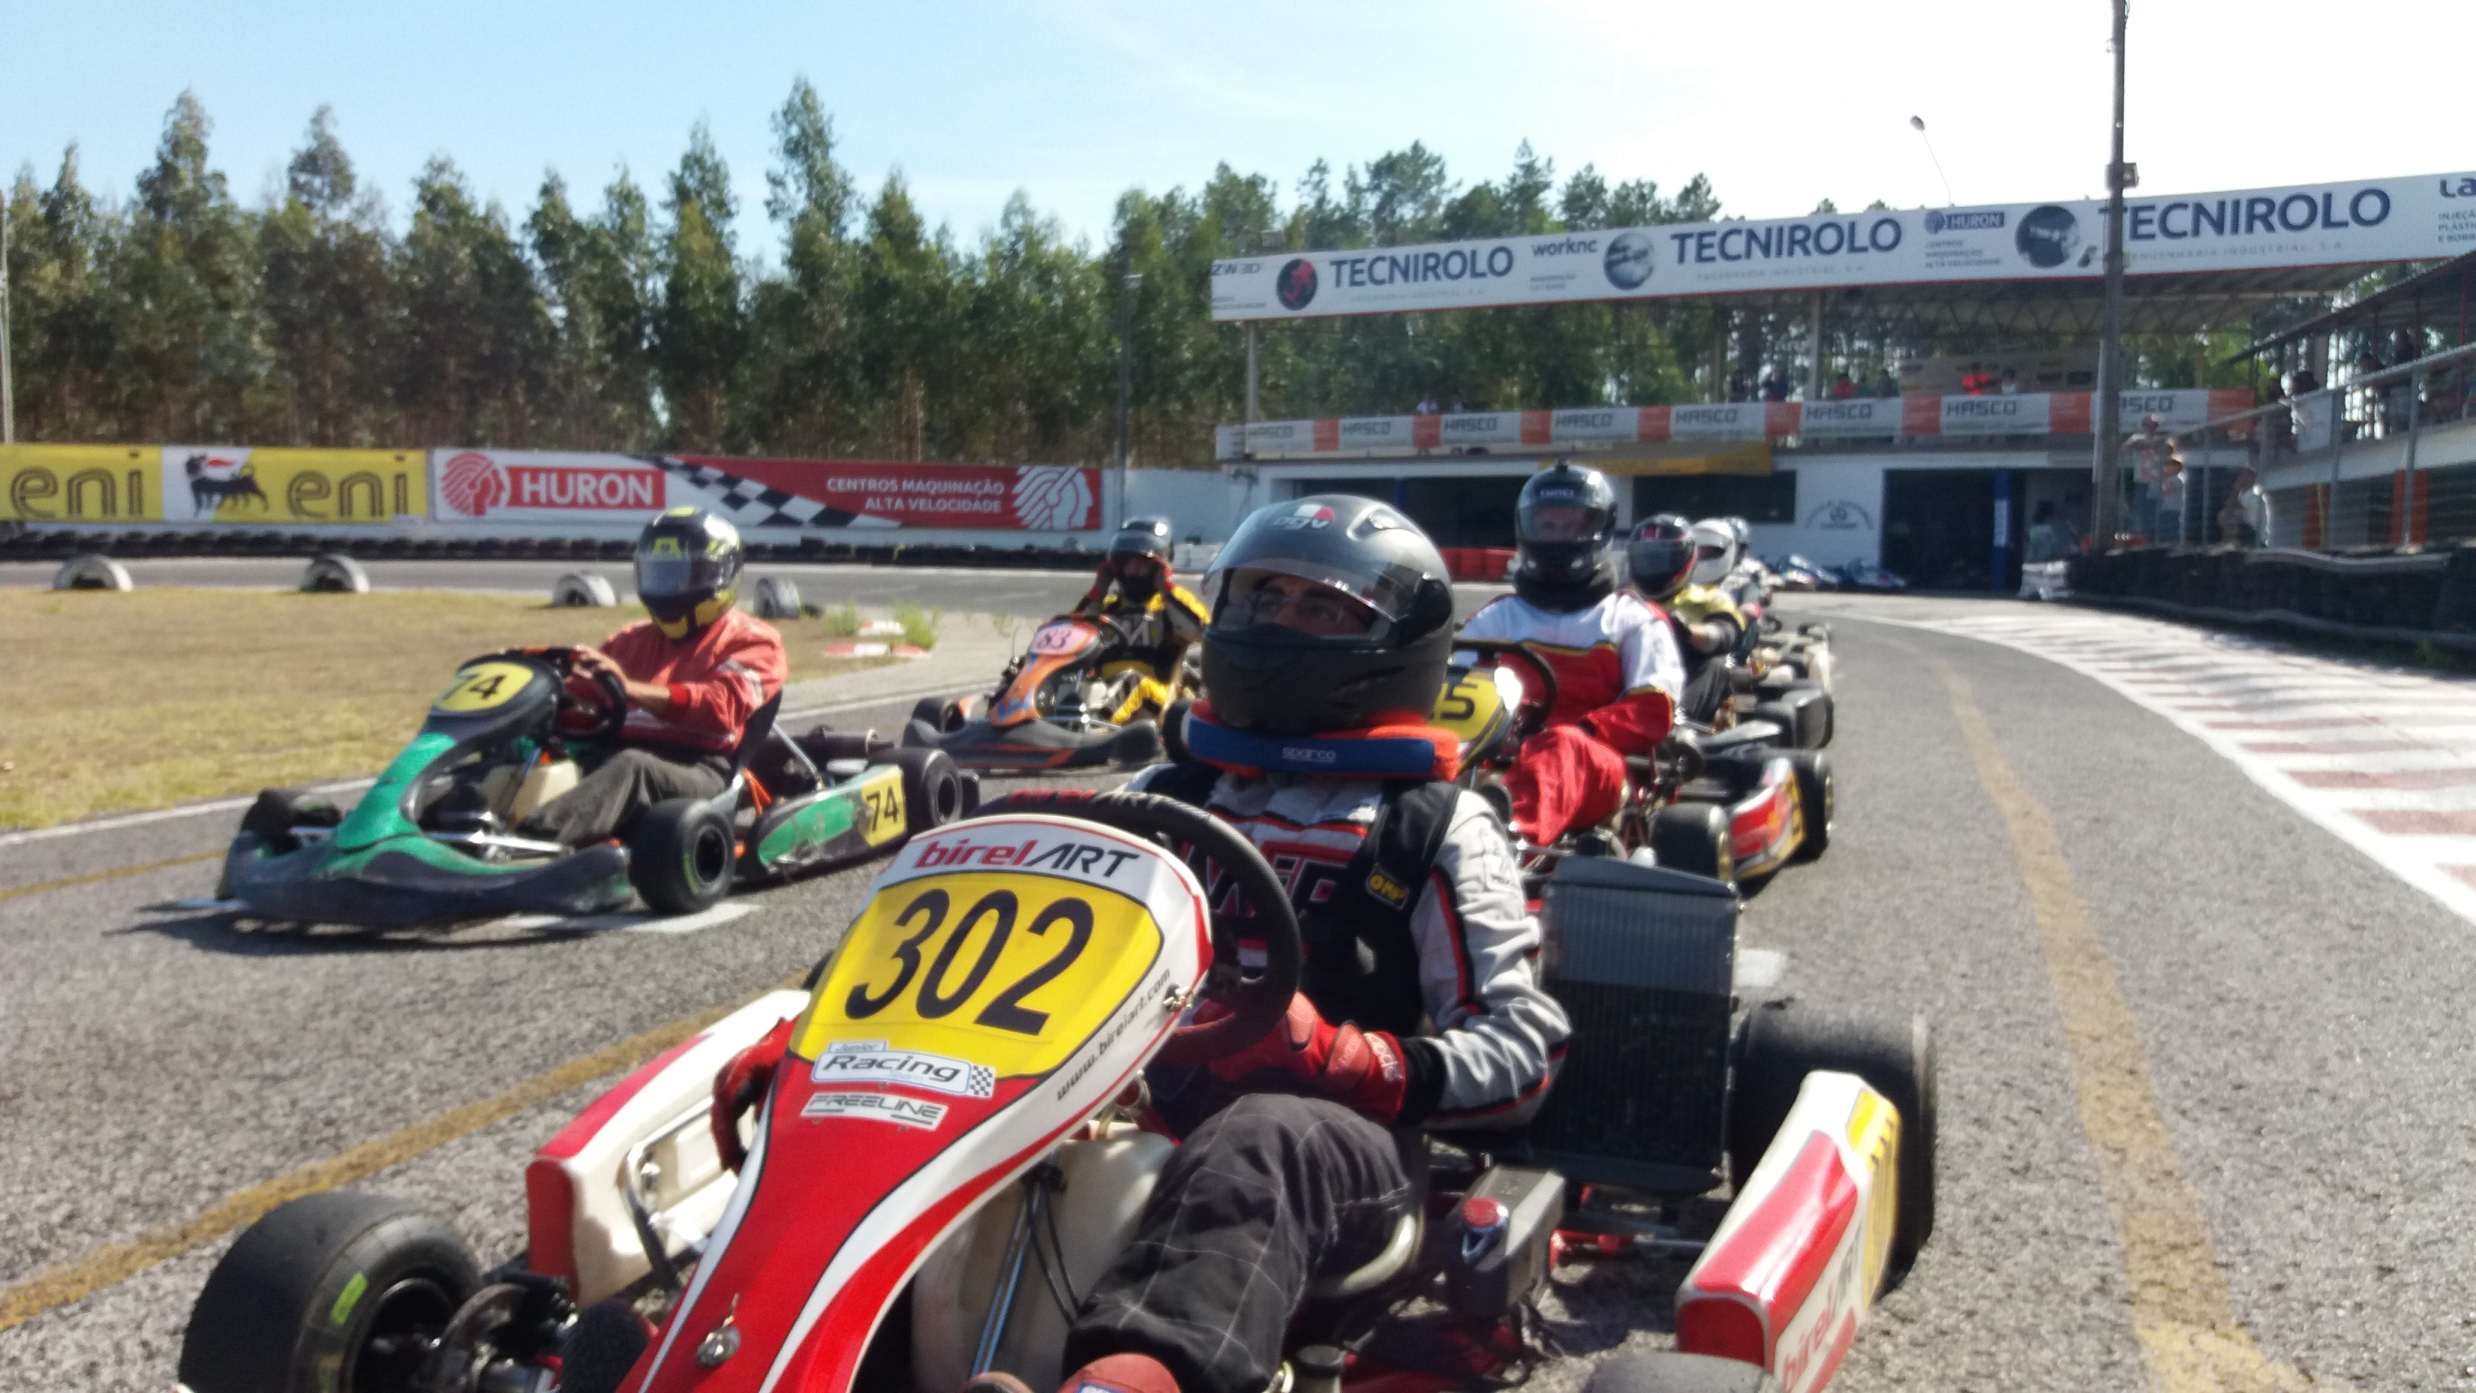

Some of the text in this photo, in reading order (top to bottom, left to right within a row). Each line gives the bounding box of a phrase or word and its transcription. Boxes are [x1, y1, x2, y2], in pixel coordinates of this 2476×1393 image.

[1950, 213, 2001, 228] HURON
[1532, 238, 1597, 257] worknc
[1670, 217, 1902, 265] TECNIROLO
[1329, 245, 1514, 290] TECNIROLO
[1676, 409, 1739, 424] HASCO
[2122, 395, 2175, 413] SCO
[1555, 413, 1613, 428] HASCO
[10, 451, 143, 519] eni
[287, 454, 409, 519] eni
[521, 471, 654, 506] HURON
[827, 478, 1005, 496] CENTROS MAQUINAÇÃO
[865, 497, 1002, 513] ALTA VELOCIDADE
[440, 673, 506, 700] 74
[866, 784, 898, 833] 74
[914, 838, 1139, 878] birelART
[844, 888, 1095, 1036] 302
[1056, 967, 1171, 1102] www.birelart.com
[823, 1054, 961, 1083] Racing
[810, 1094, 942, 1119] FREELINE
